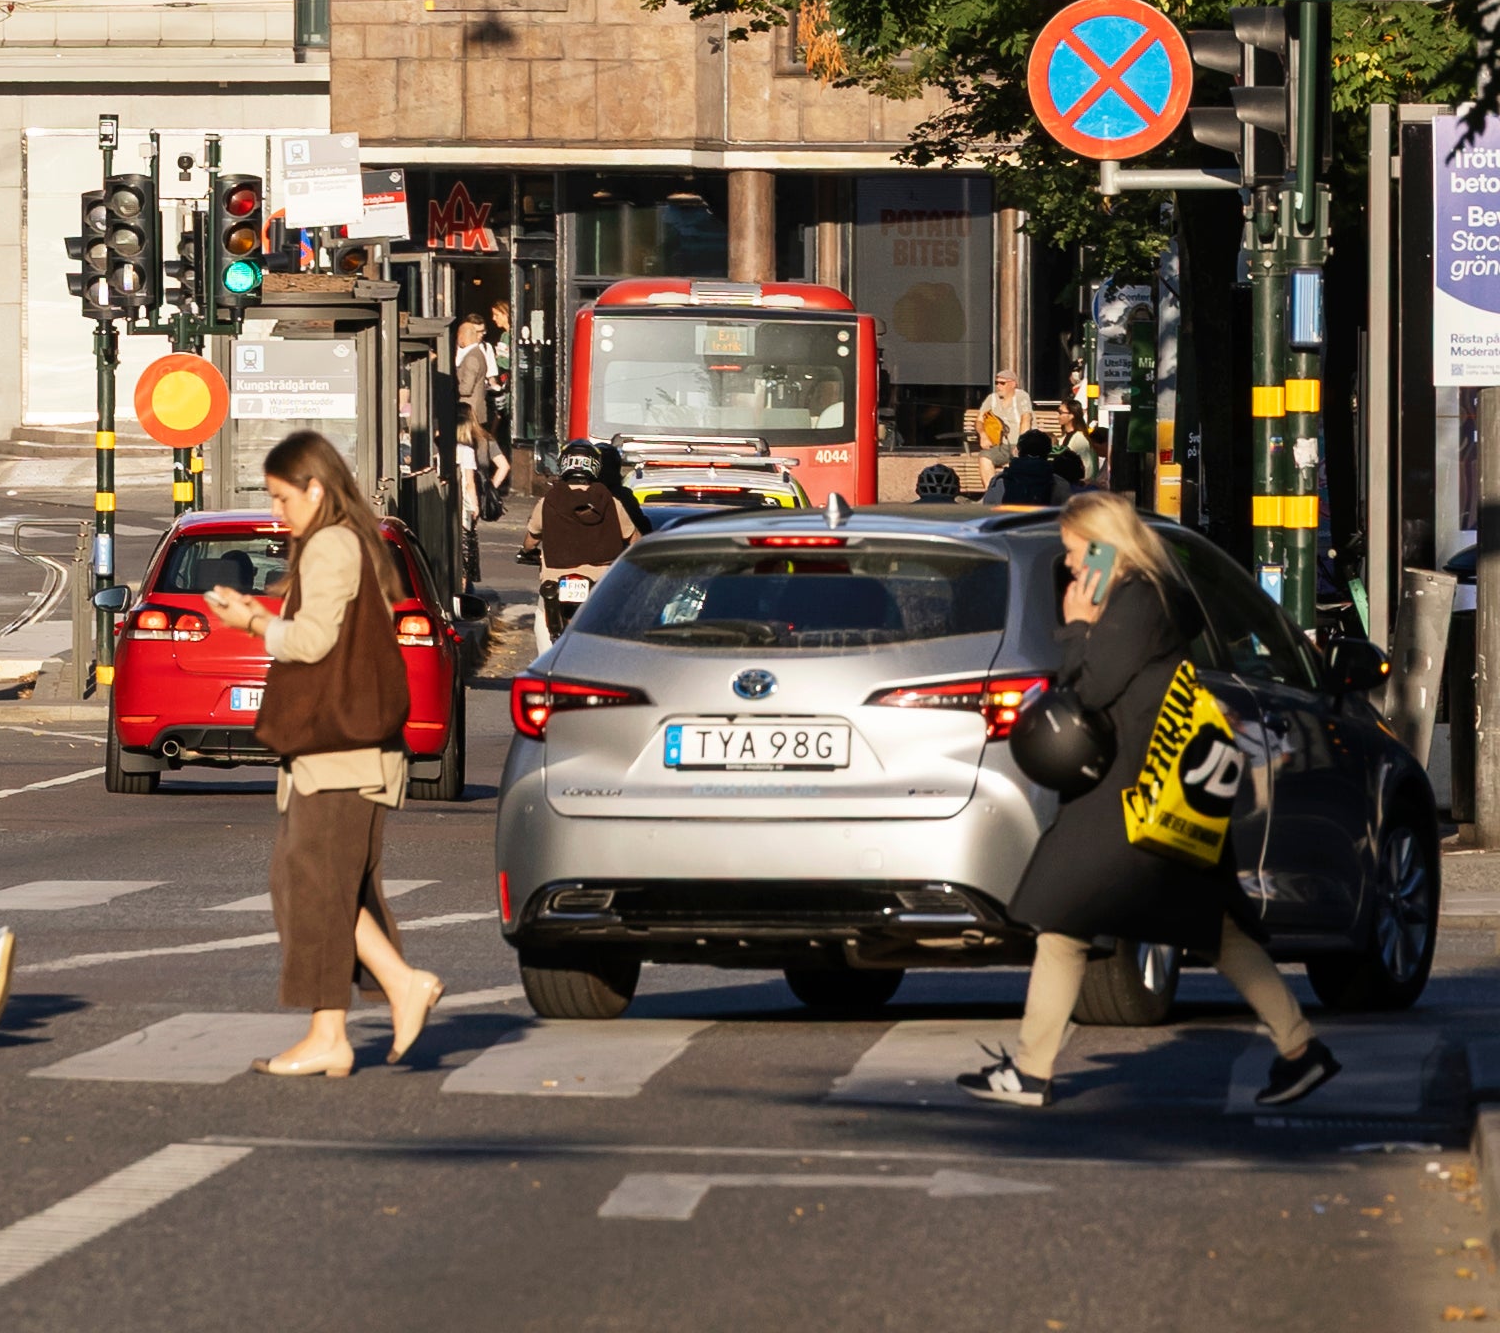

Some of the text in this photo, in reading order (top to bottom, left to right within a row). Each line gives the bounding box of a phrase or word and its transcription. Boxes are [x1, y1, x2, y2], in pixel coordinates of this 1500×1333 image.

[427, 181, 493, 251] MAX
[1467, 205, 1500, 227] Be
[1450, 229, 1500, 252] Stoc
[892, 238, 960, 267] BITES
[1450, 254, 1500, 282] grön
[1450, 333, 1483, 344] Rösta
[1450, 346, 1500, 357] Moderat
[1104, 369, 1120, 378] ska
[236, 379, 330, 393] Kungsträdgården
[815, 450, 849, 463] 4044
[696, 730, 834, 760] TYA 98G
[1183, 740, 1245, 798] JD
